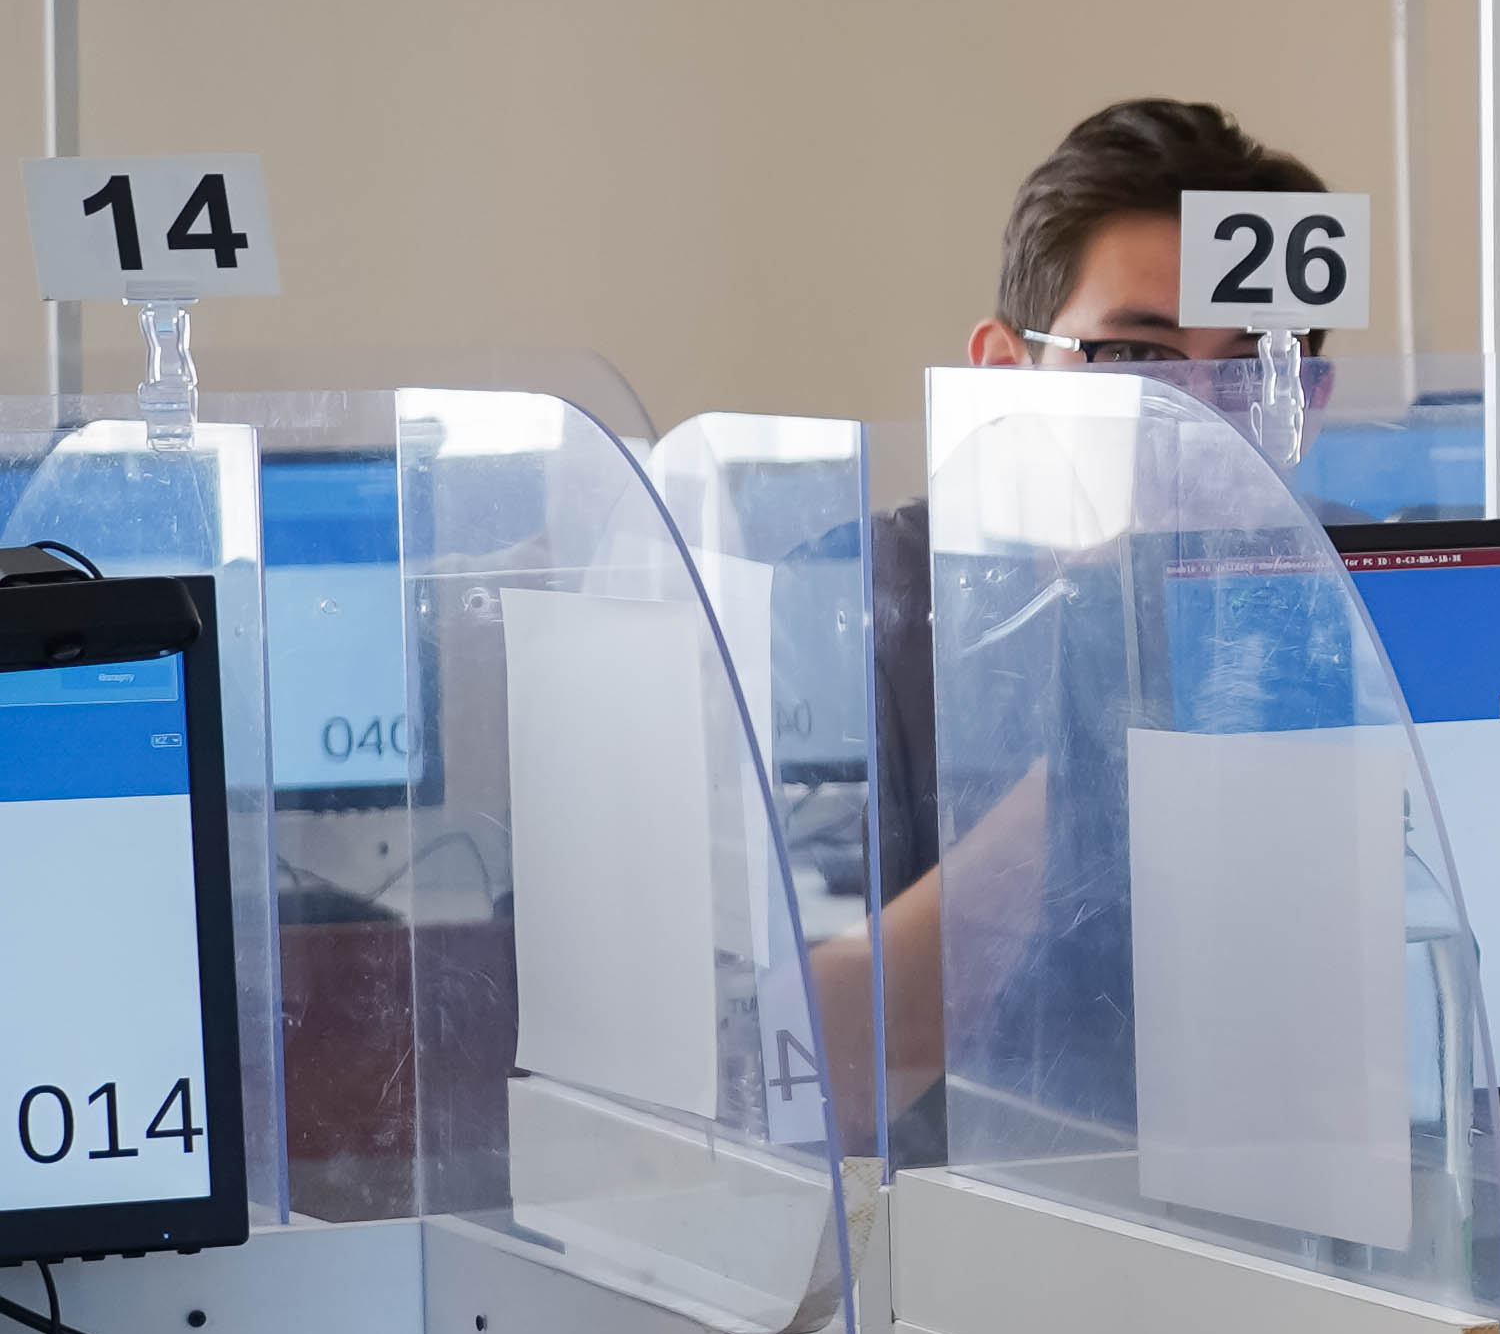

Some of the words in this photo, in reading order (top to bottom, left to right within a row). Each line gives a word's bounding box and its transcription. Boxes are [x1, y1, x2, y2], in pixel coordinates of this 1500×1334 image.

[82, 173, 249, 270] 14
[1210, 212, 1348, 306] 26
[1363, 556, 1374, 565] PC
[322, 715, 421, 759] 040
[18, 1077, 204, 1164] 014
